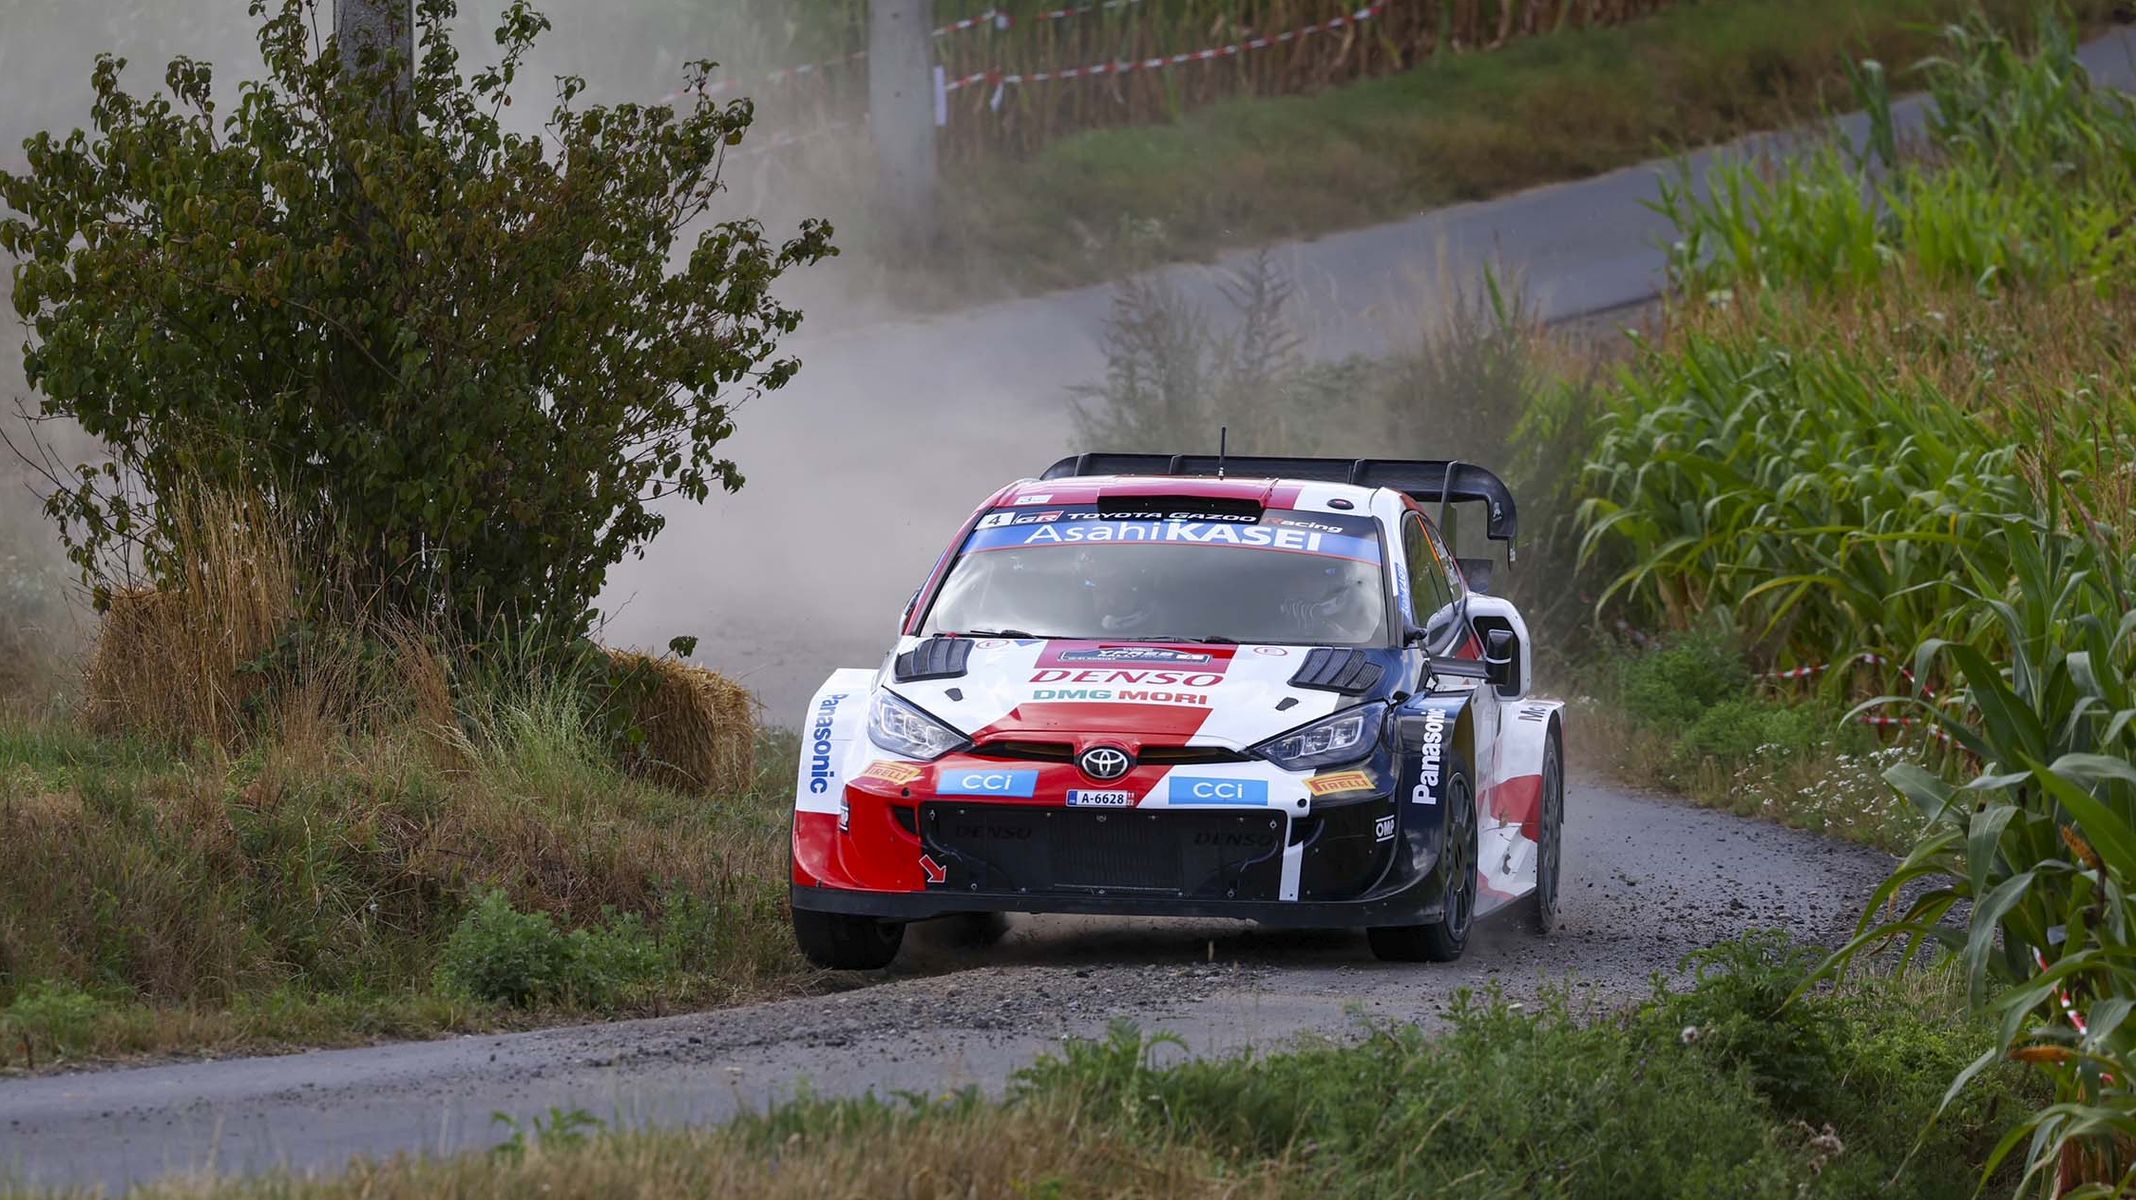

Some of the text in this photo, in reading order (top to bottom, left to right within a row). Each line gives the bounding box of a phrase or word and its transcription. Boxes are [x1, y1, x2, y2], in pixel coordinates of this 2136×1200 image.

[988, 512, 1001, 525] 4
[1067, 511, 1344, 534] TOYOTA GAZOO Racing
[1028, 669, 1224, 688] DENSO
[1032, 689, 1208, 705] DMG MORI
[809, 692, 849, 795] Panasonic
[1411, 708, 1447, 806] Panasonic
[1310, 773, 1367, 793] PIRELLI
[1081, 793, 1124, 805] A-6628
[1375, 819, 1395, 838] OMP
